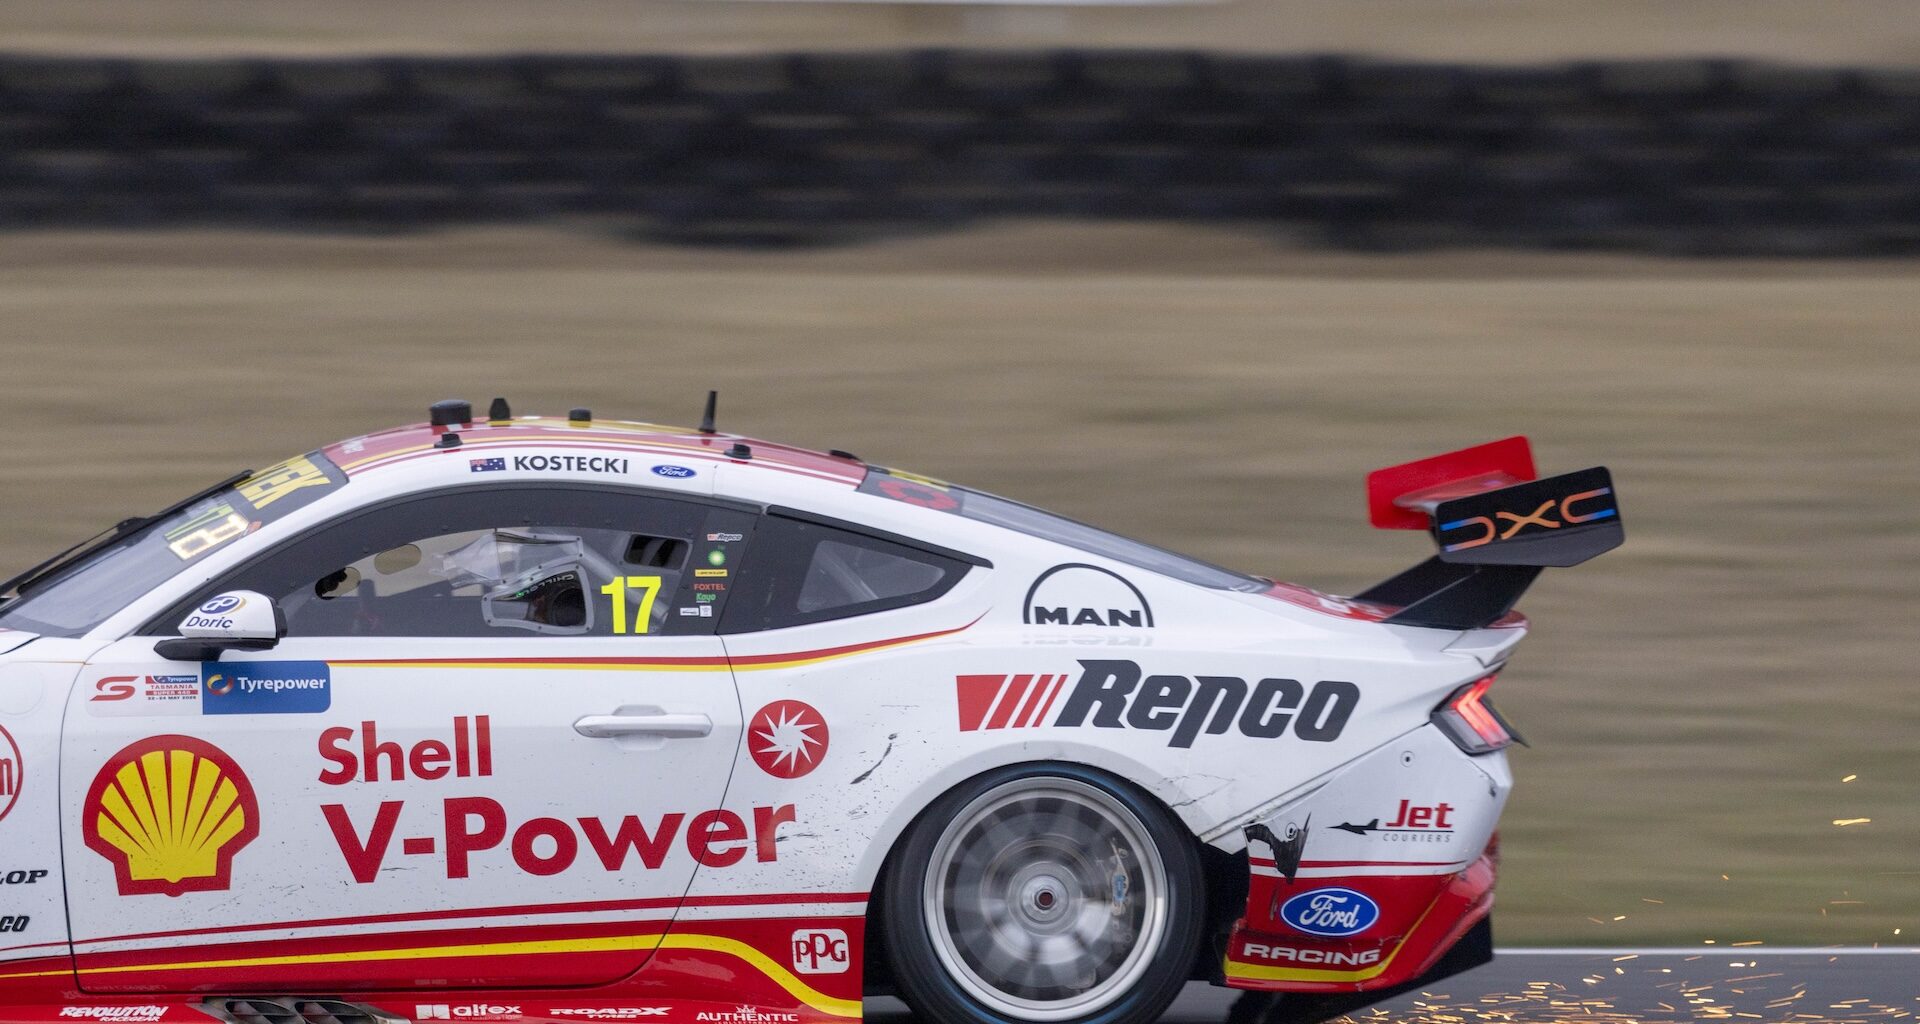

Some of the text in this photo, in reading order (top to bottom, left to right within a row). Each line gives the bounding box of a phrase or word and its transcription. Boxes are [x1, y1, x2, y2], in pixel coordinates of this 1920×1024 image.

[513, 455, 629, 475] KOSTECKI
[658, 464, 691, 478] Ford
[1439, 487, 1617, 553] DXC
[694, 583, 726, 591] FOXTEL
[600, 576, 662, 634] 17
[696, 592, 717, 603] Kayo
[185, 616, 234, 629] Doric
[1035, 607, 1141, 627] MAN
[237, 676, 327, 693] Tyrepower
[1056, 659, 1360, 748] Repco
[318, 715, 493, 785] Shell
[1386, 799, 1455, 829] Jet
[319, 797, 796, 884] V-Power
[1383, 832, 1452, 843] COURIERS
[1299, 894, 1361, 929] Ford
[794, 934, 846, 969] PPG
[1243, 943, 1381, 966] RACING
[59, 1005, 169, 1018] REVOLUTION
[452, 1004, 522, 1017] alfex
[549, 1007, 672, 1015] ROADX
[696, 1012, 799, 1022] AUTHENTIC
